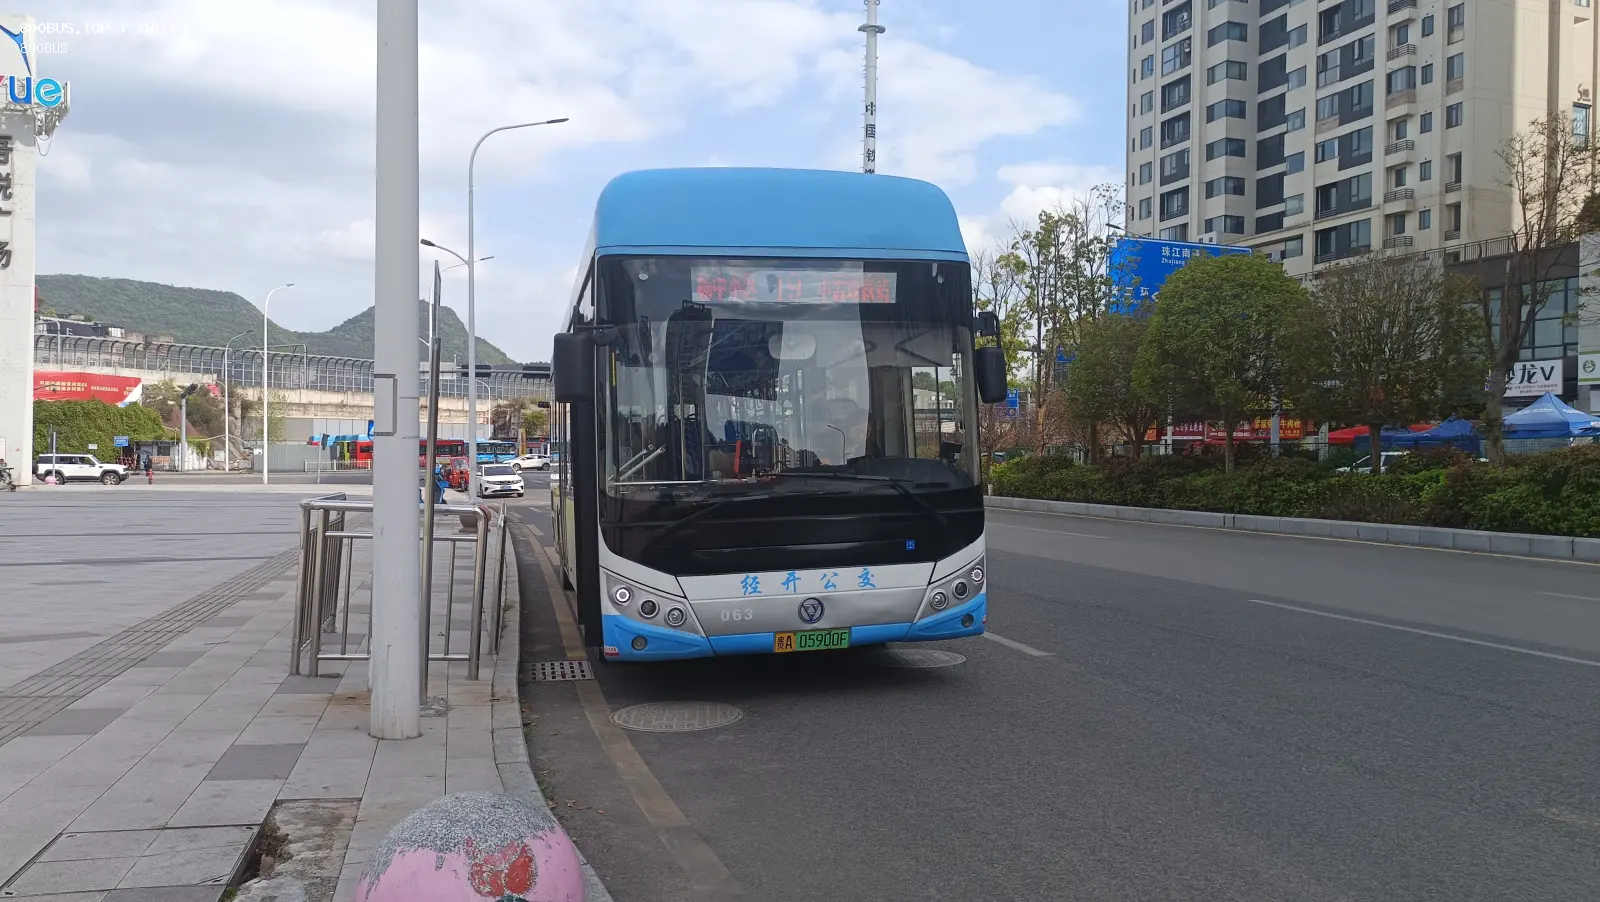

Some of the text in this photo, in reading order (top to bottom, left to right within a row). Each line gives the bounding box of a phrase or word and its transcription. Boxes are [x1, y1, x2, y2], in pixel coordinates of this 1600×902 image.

[0, 75, 64, 108] ue
[740, 567, 877, 596] 经开公交
[720, 608, 754, 622] 063
[776, 631, 849, 651] 贵A 05900F
